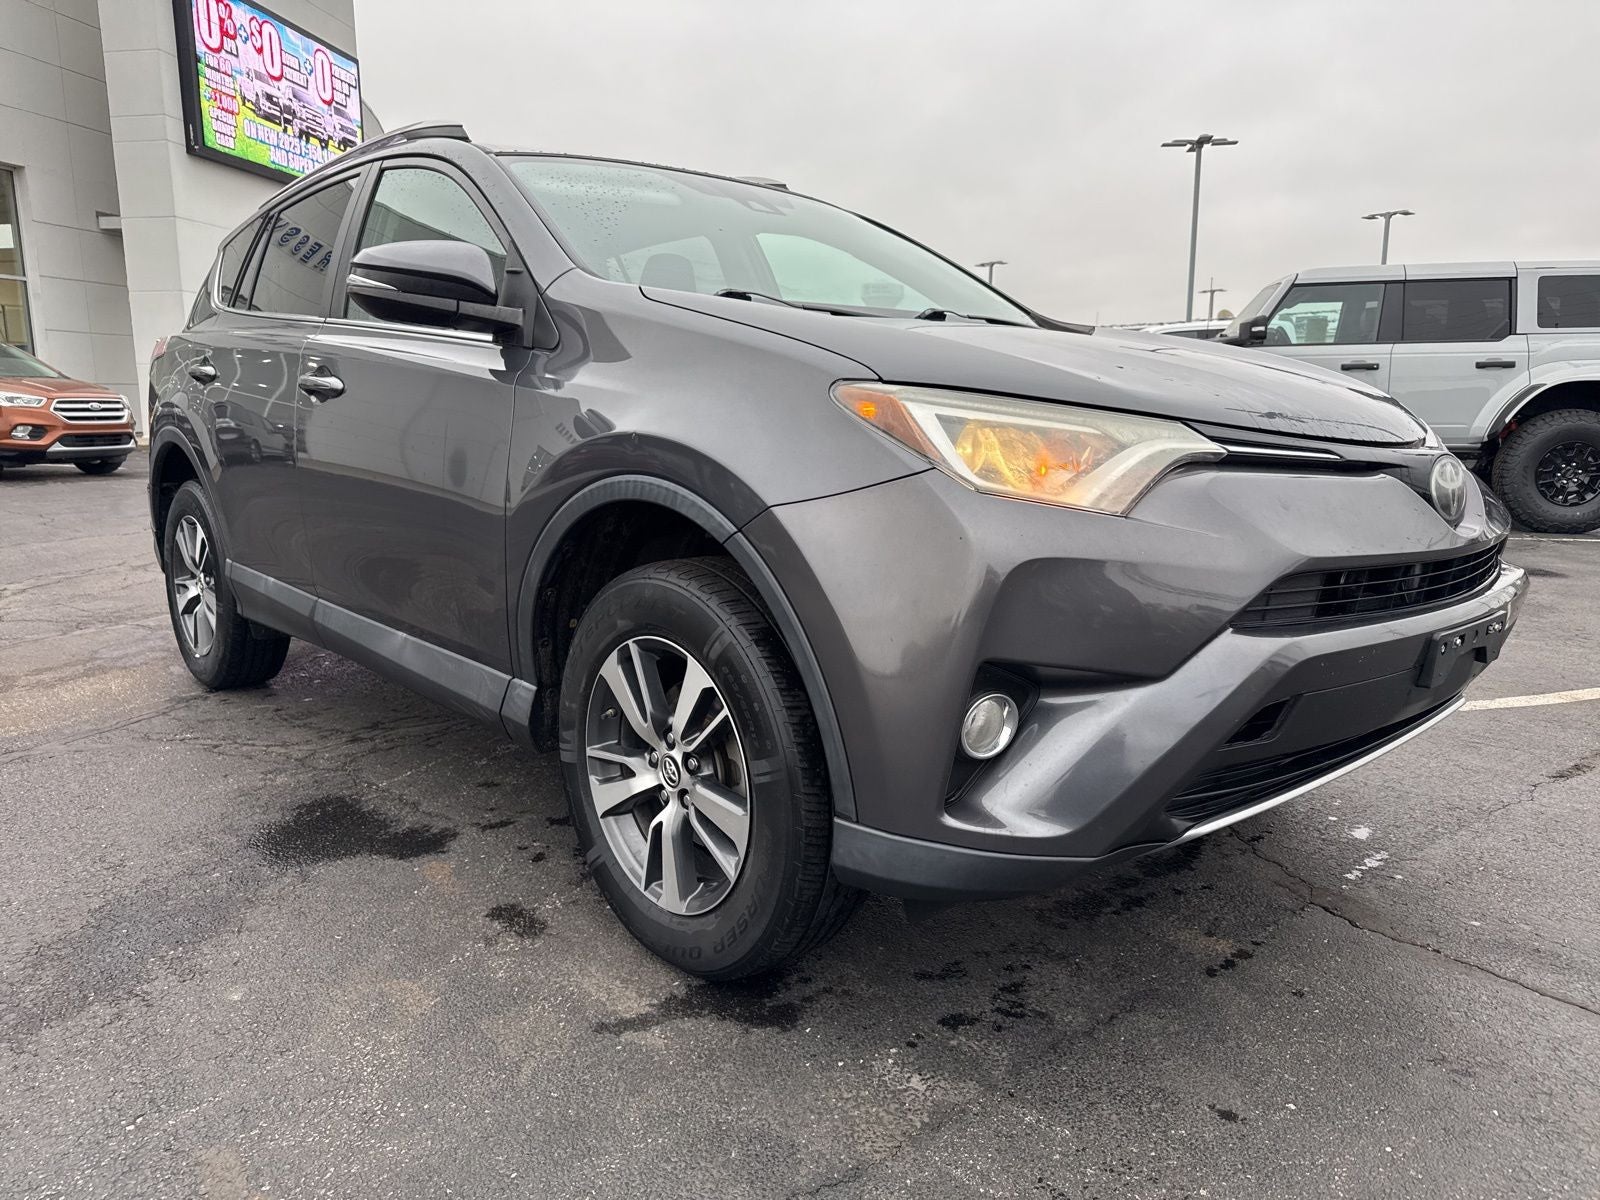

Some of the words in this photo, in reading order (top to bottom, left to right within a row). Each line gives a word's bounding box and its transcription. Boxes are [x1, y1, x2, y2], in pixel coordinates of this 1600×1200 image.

[204, 51, 219, 69] FOR
[249, 16, 284, 81] $0
[314, 49, 334, 105] 0
[242, 117, 257, 139] ON
[256, 123, 279, 147] NEW
[277, 131, 300, 154] 2025
